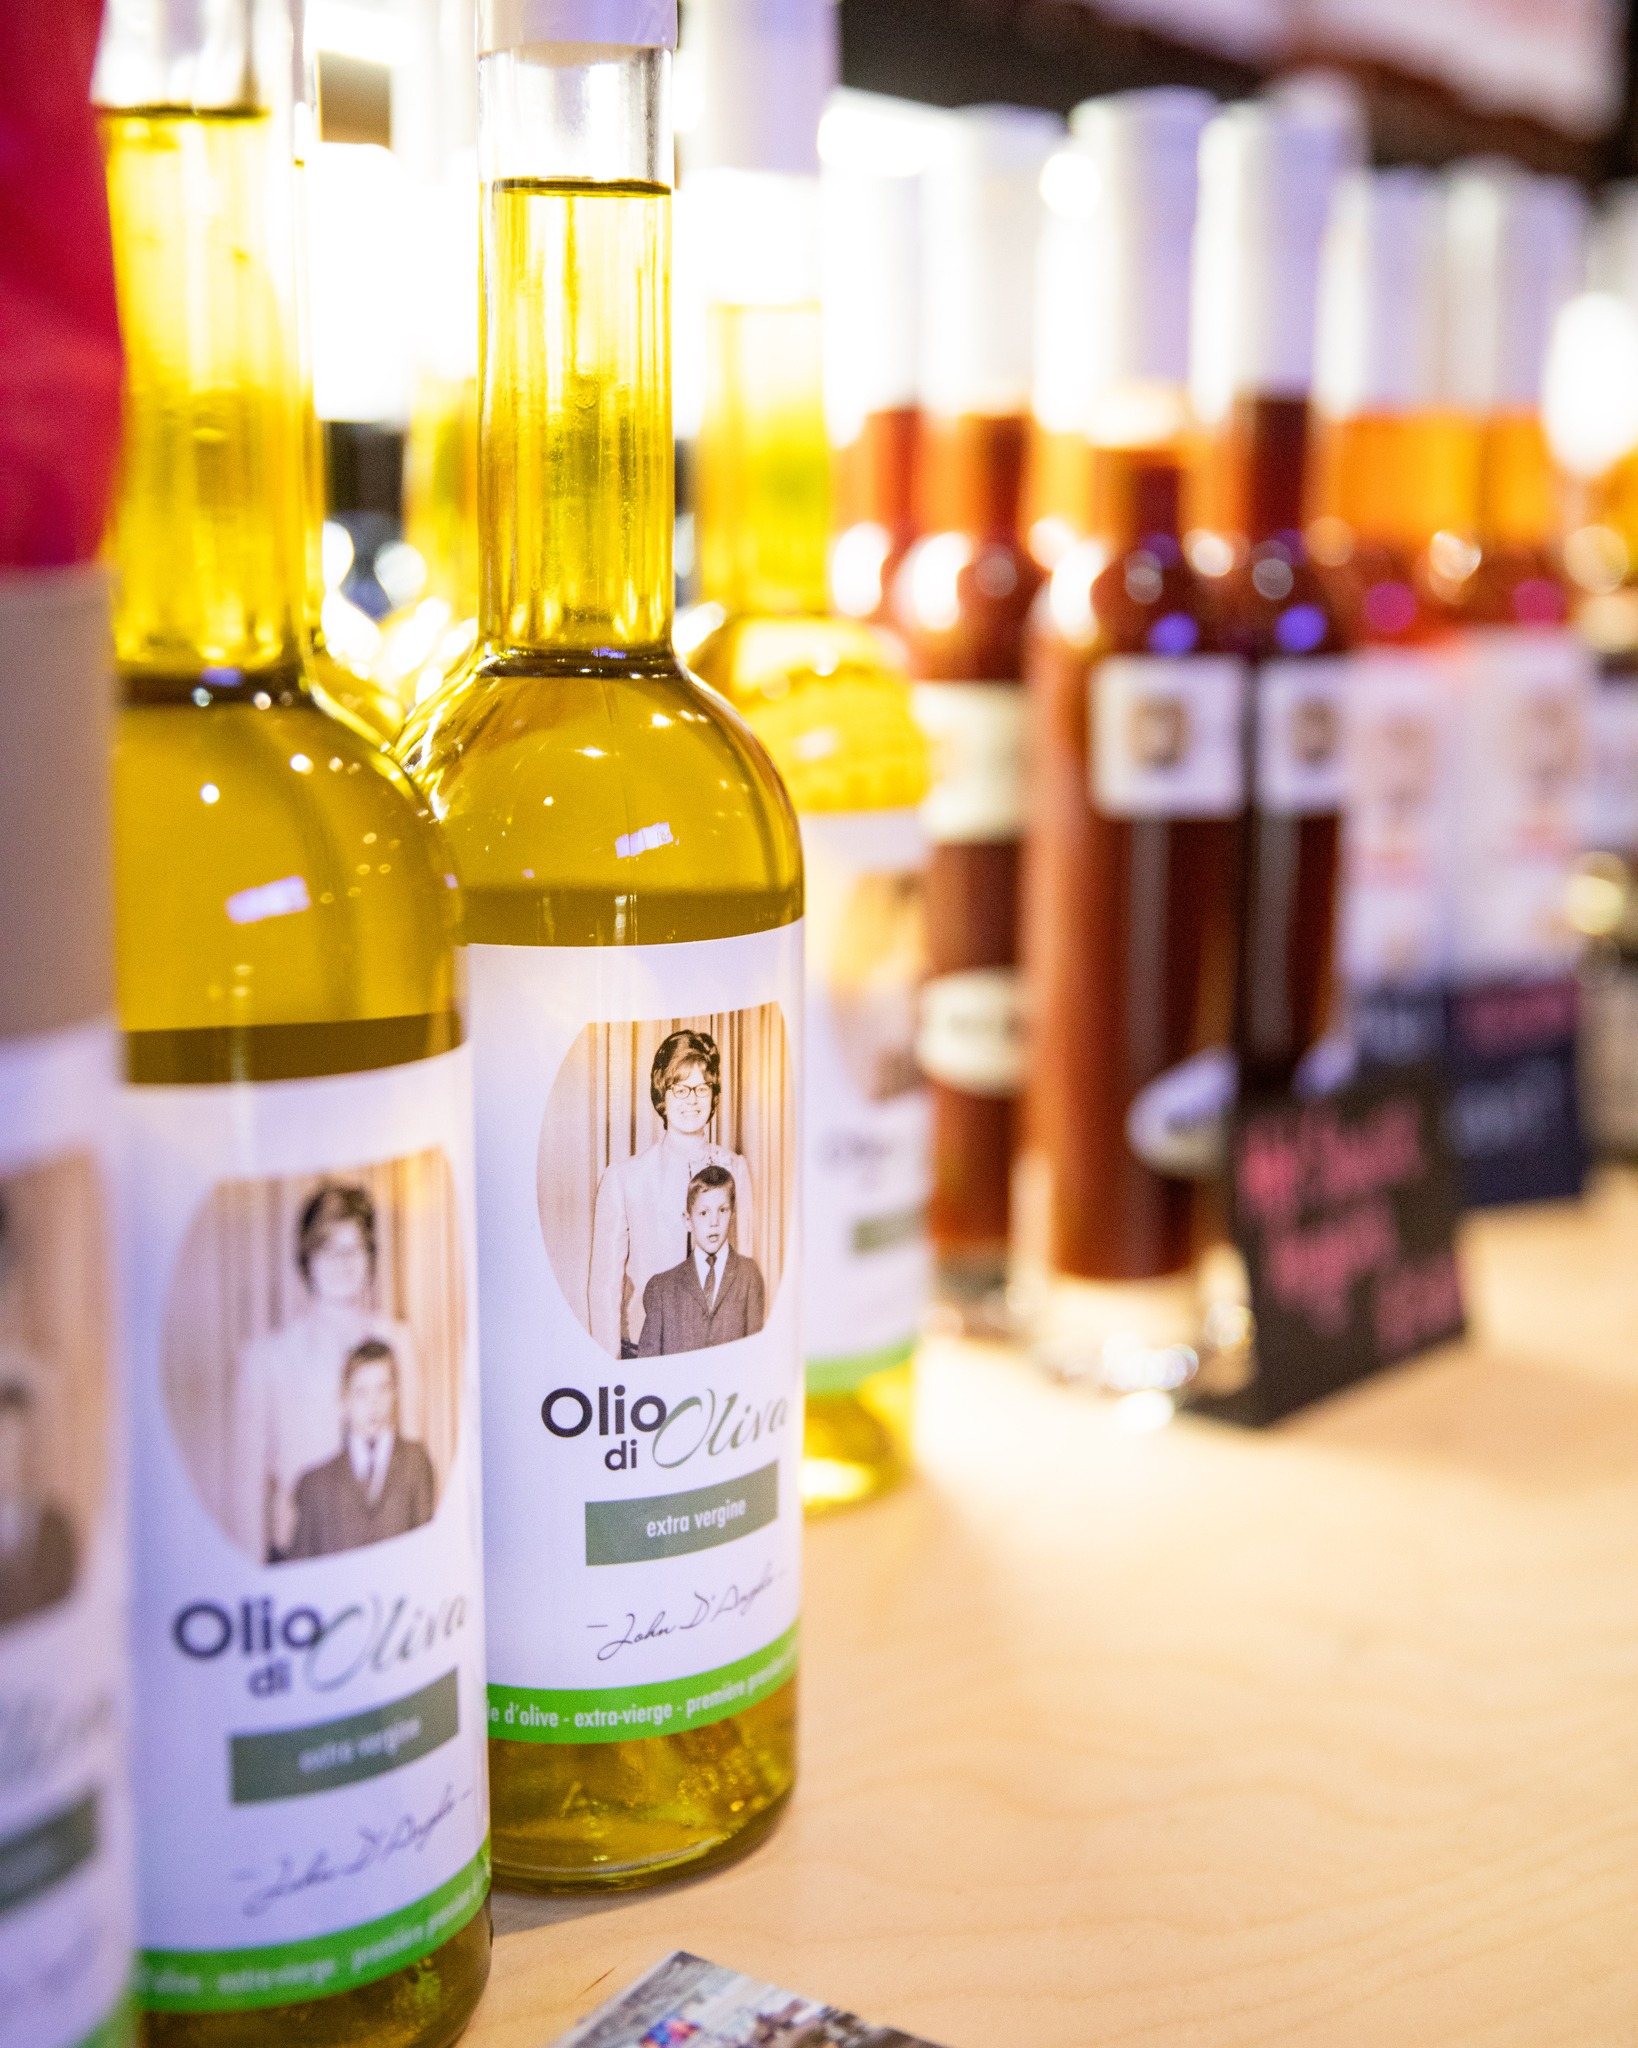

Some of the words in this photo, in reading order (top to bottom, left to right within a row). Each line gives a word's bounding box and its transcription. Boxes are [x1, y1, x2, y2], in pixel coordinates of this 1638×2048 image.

[541, 1384, 667, 1438] Olio
[652, 1388, 787, 1469] Oliva
[604, 1439, 637, 1471] di
[646, 1515, 690, 1538] extra
[694, 1499, 747, 1529] vergine
[172, 1598, 322, 1661] Olio
[305, 1594, 469, 1691] Oliva
[597, 1612, 676, 1661] John
[248, 1660, 291, 1696] di
[505, 1702, 559, 1728] d'olive
[574, 1703, 672, 1728] extra-vierge
